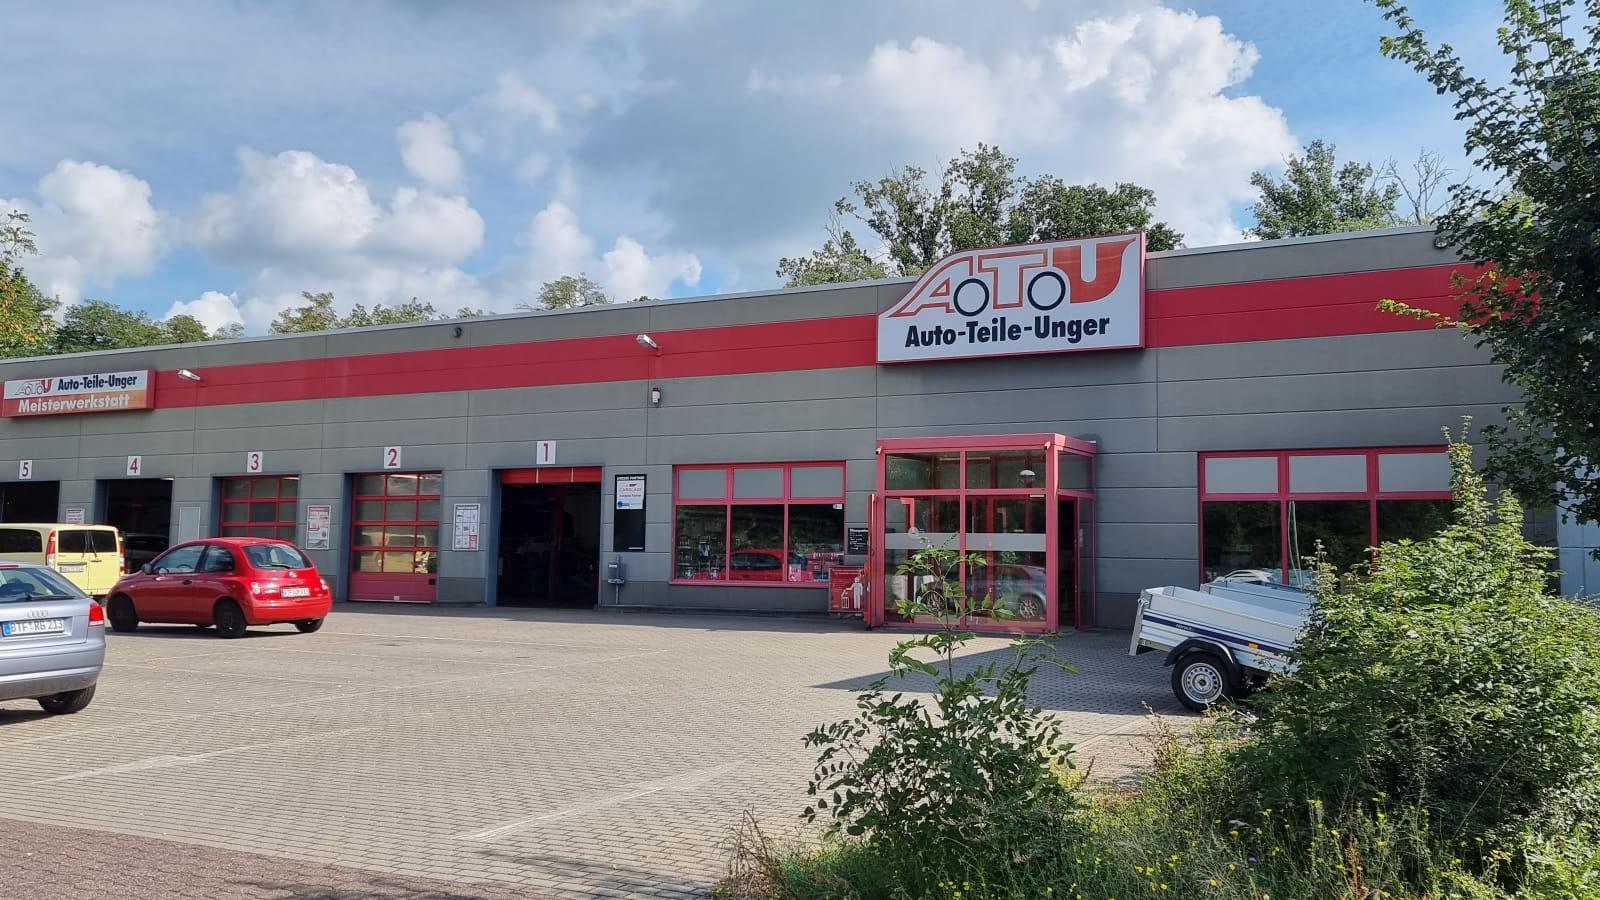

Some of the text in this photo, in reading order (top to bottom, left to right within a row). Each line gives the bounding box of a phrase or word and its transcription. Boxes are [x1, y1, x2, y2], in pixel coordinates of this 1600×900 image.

[905, 315, 1110, 348] Auto-Teile-Unger
[58, 375, 138, 391] Auto-Teile-Unger
[18, 394, 131, 413] Meisterwerkstatt
[387, 448, 398, 467] 2
[543, 443, 549, 462] 1
[22, 462, 29, 477] 5
[130, 458, 138, 474] 4
[250, 453, 260, 471] 3
